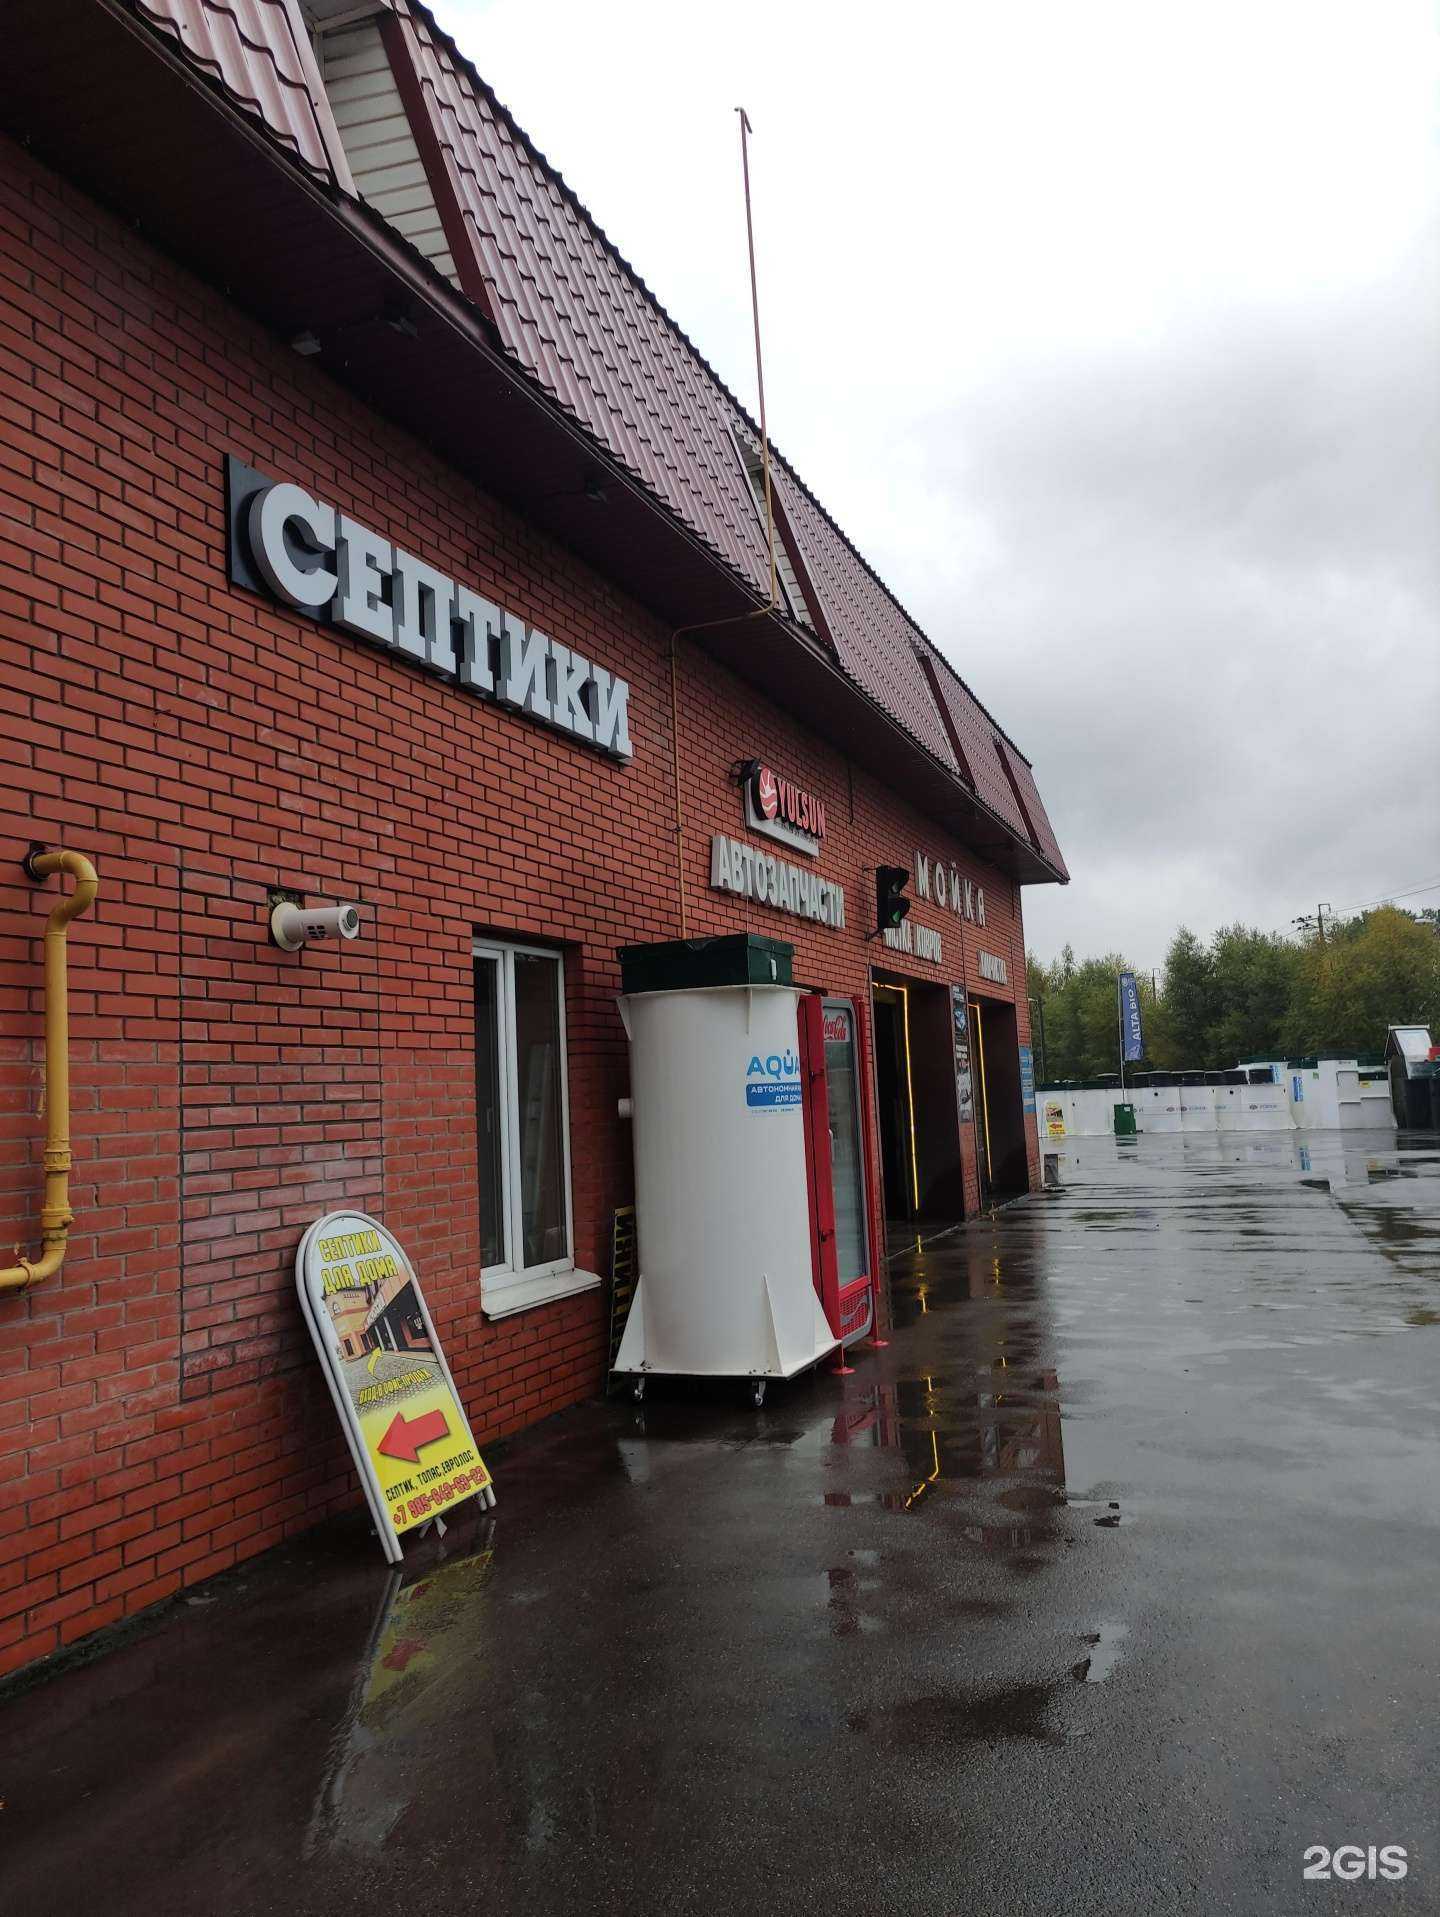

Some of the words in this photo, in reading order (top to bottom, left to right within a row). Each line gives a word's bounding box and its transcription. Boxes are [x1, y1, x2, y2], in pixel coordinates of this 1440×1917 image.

[250, 483, 632, 760] СЕПТИКИ
[777, 777, 826, 839] YULSUN
[711, 835, 846, 929] АВТОЗАПЧАСТИ
[914, 850, 986, 927] МОЙКА
[1128, 988, 1138, 1010] BIO
[1130, 1011, 1142, 1041] ALTA
[319, 1230, 382, 1262] СЕПТИКИ
[321, 1263, 355, 1296] ДЛЯ
[355, 1255, 399, 1287] ДОМА
[385, 1478, 418, 1502] СЕПТИК,
